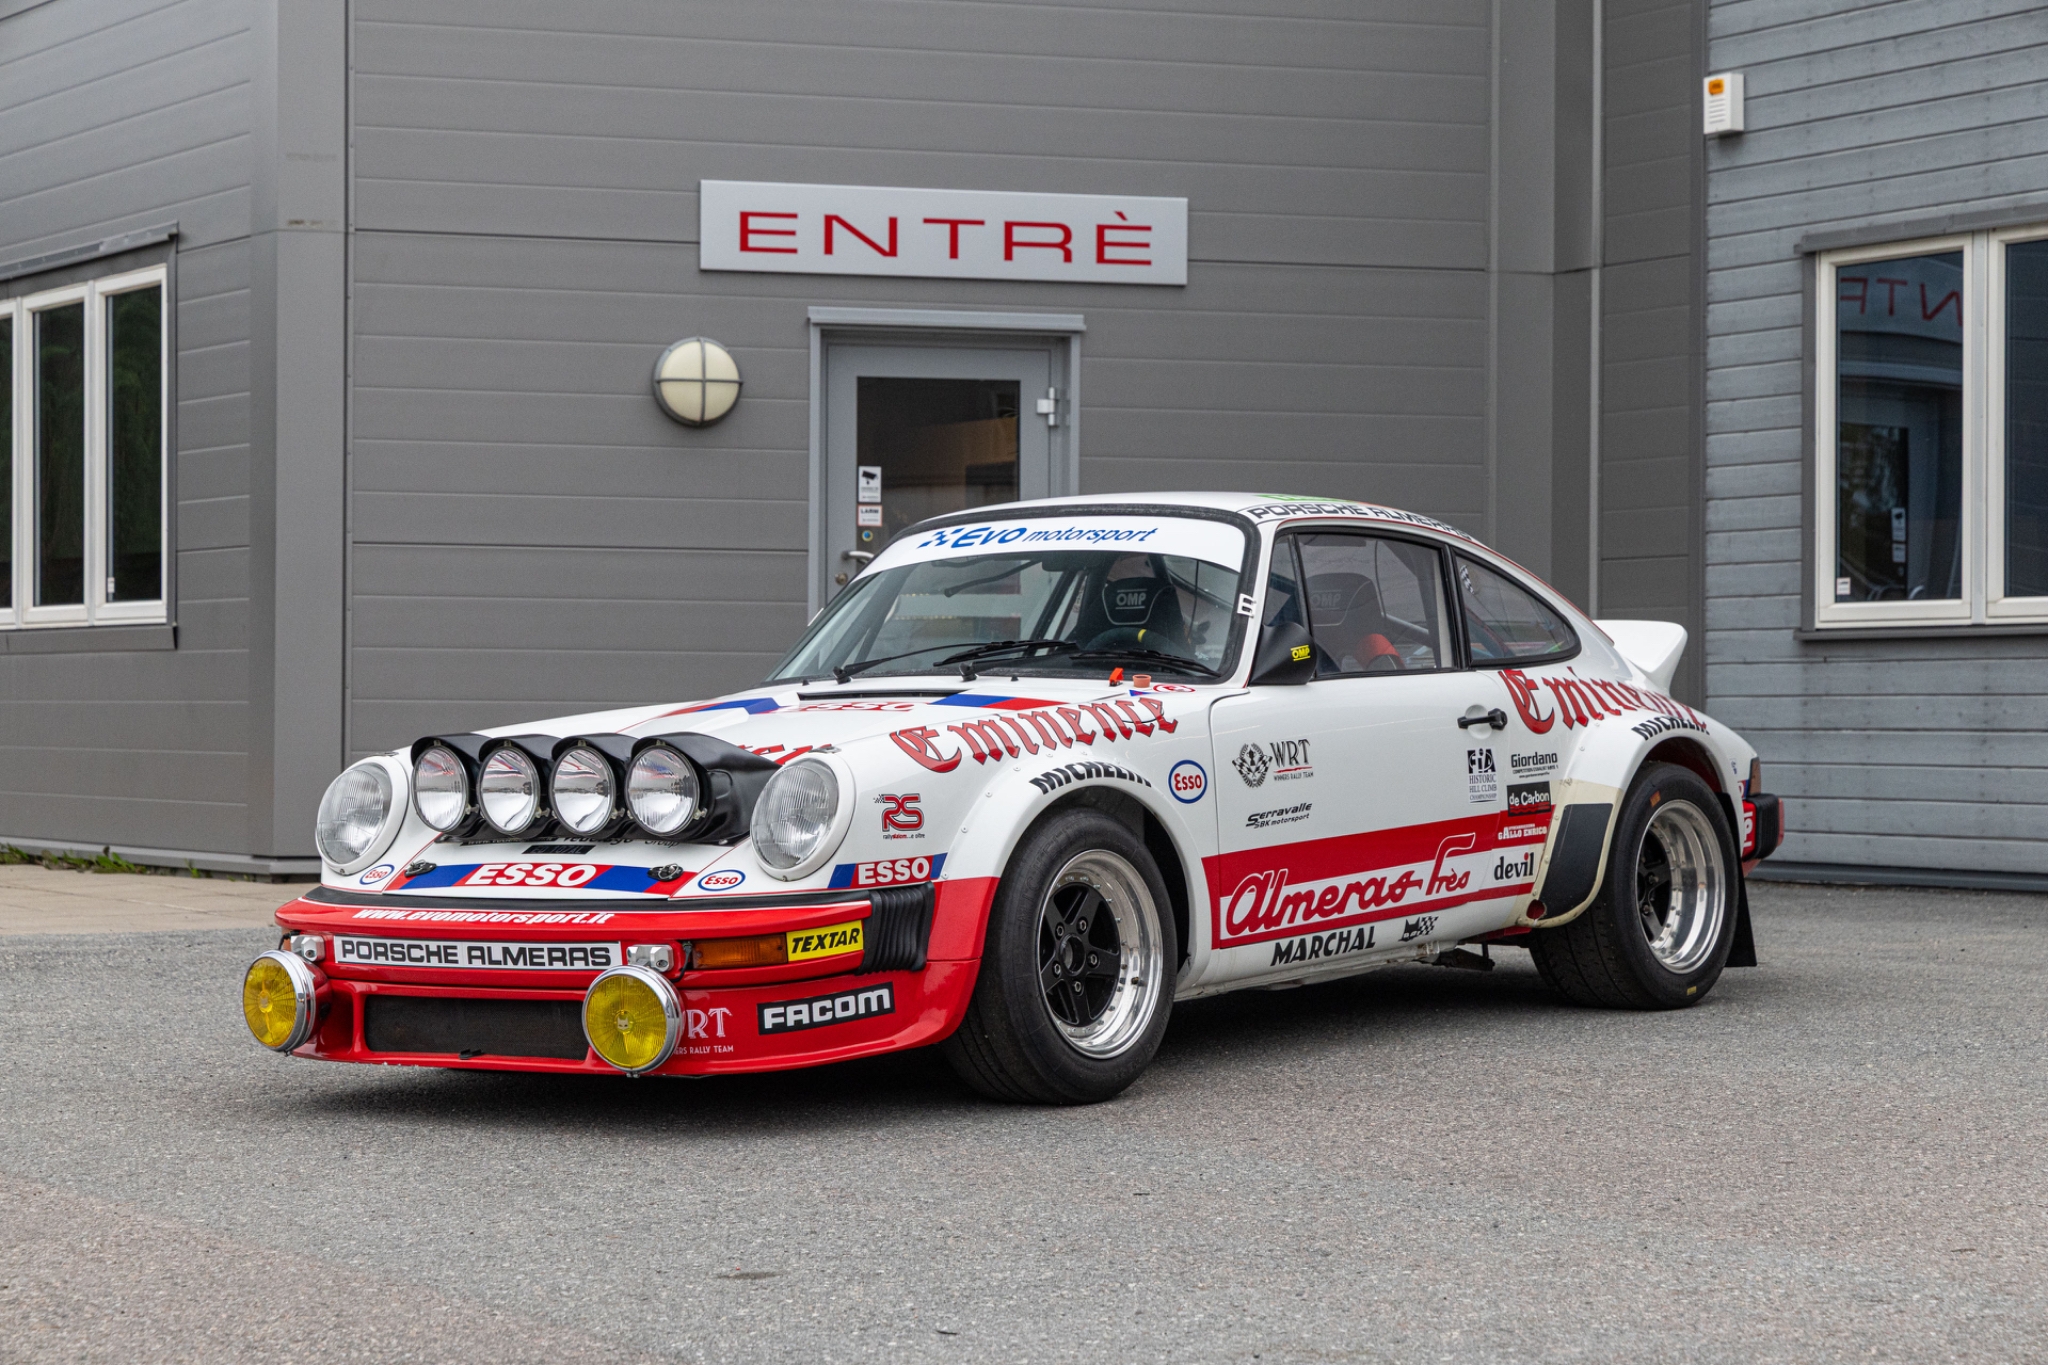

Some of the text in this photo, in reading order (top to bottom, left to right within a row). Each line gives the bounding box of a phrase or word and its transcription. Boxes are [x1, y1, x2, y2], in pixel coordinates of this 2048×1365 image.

[739, 210, 1153, 266] ENTRÈ
[1248, 503, 1369, 519] PORSCHE
[1022, 527, 1159, 544] motorsport
[1116, 592, 1147, 606] OMP
[1291, 646, 1311, 659] OMP
[1269, 739, 1311, 767] WRT
[1511, 751, 1558, 768] Giordano
[1469, 774, 1496, 784] HISTORIC
[1482, 784, 1497, 792] CLIMB
[1509, 790, 1550, 806] de Carbon
[881, 793, 924, 832] RS
[1245, 803, 1313, 827] Serravalle
[1254, 813, 1309, 829] SBK motorsport
[1523, 826, 1548, 837] ENRICO
[465, 863, 597, 886] ESSO
[858, 857, 930, 885] ESSO
[1494, 852, 1535, 880] devil
[352, 908, 615, 925] www.evomotorsport.it
[791, 927, 861, 954] TEXTAR
[1270, 926, 1376, 966] MARCHAL
[341, 940, 612, 967] PORSCHE ALMERAS
[764, 988, 891, 1029] FACOM
[687, 1007, 733, 1039] RT
[689, 1045, 711, 1055] RALLY
[713, 1045, 734, 1053] TEAM
